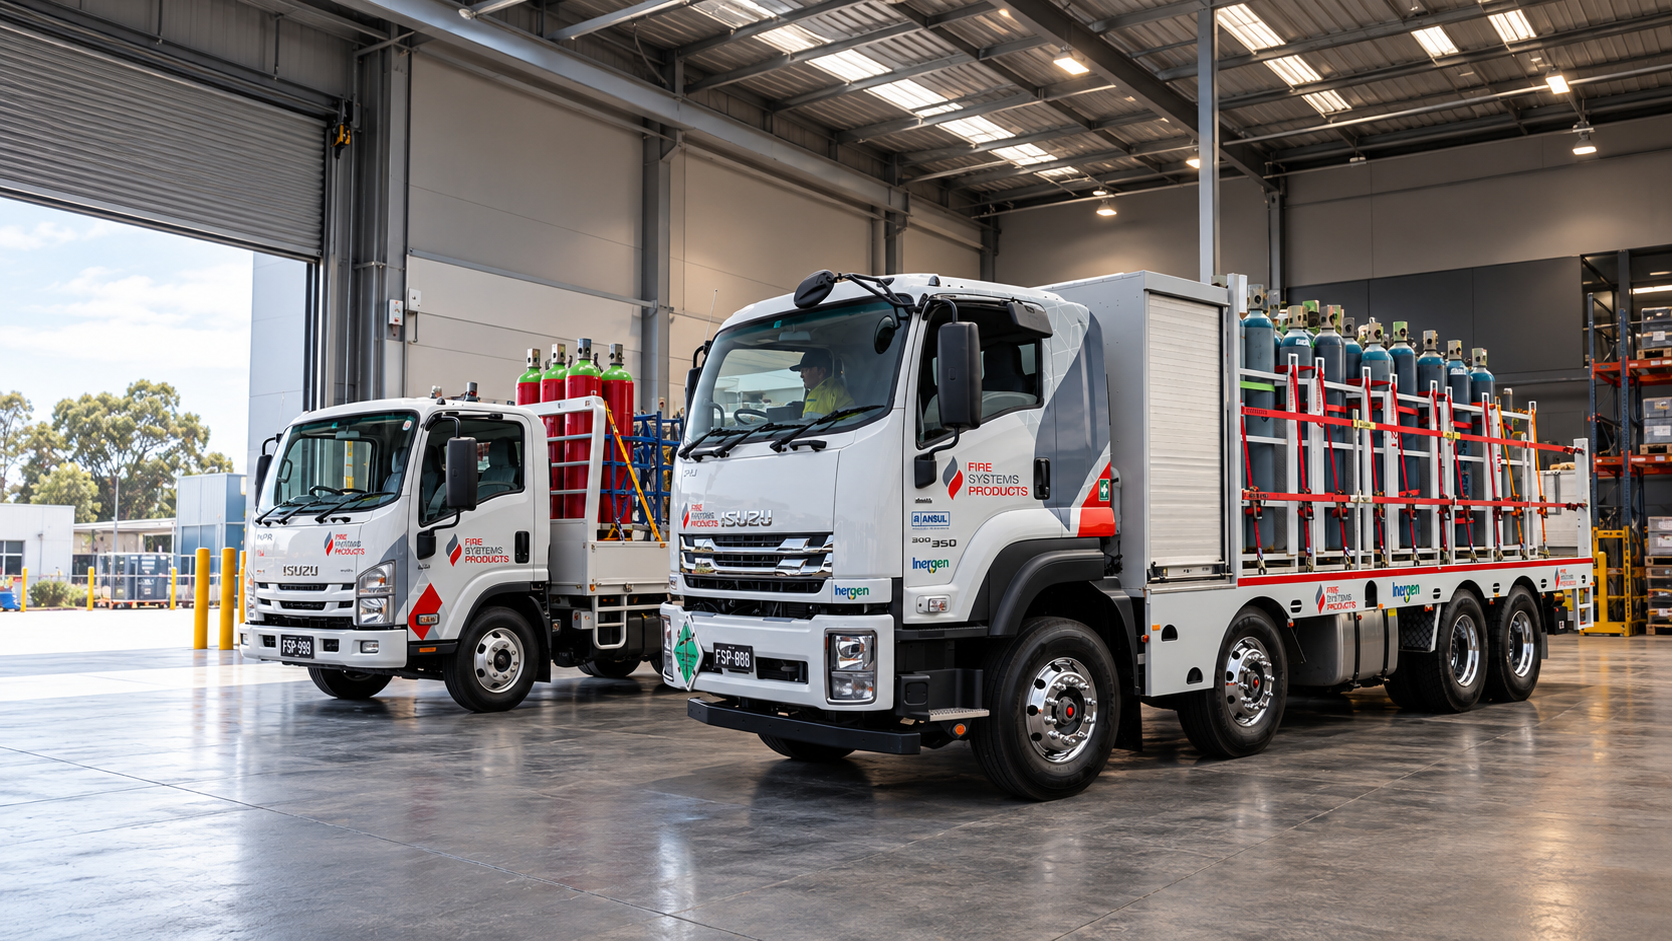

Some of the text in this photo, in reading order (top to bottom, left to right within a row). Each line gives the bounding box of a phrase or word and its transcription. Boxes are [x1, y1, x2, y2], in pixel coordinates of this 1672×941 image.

[968, 462, 992, 473] FIRE
[968, 474, 1019, 485] SYSTEMS
[968, 486, 1028, 496] PRODUCTS
[721, 510, 773, 527] ISUZU
[922, 515, 947, 523] ANSUL
[465, 538, 483, 546] FIRE
[283, 566, 318, 576] ISUZU
[912, 557, 949, 574] Inergen
[715, 649, 750, 669] FSP-888
